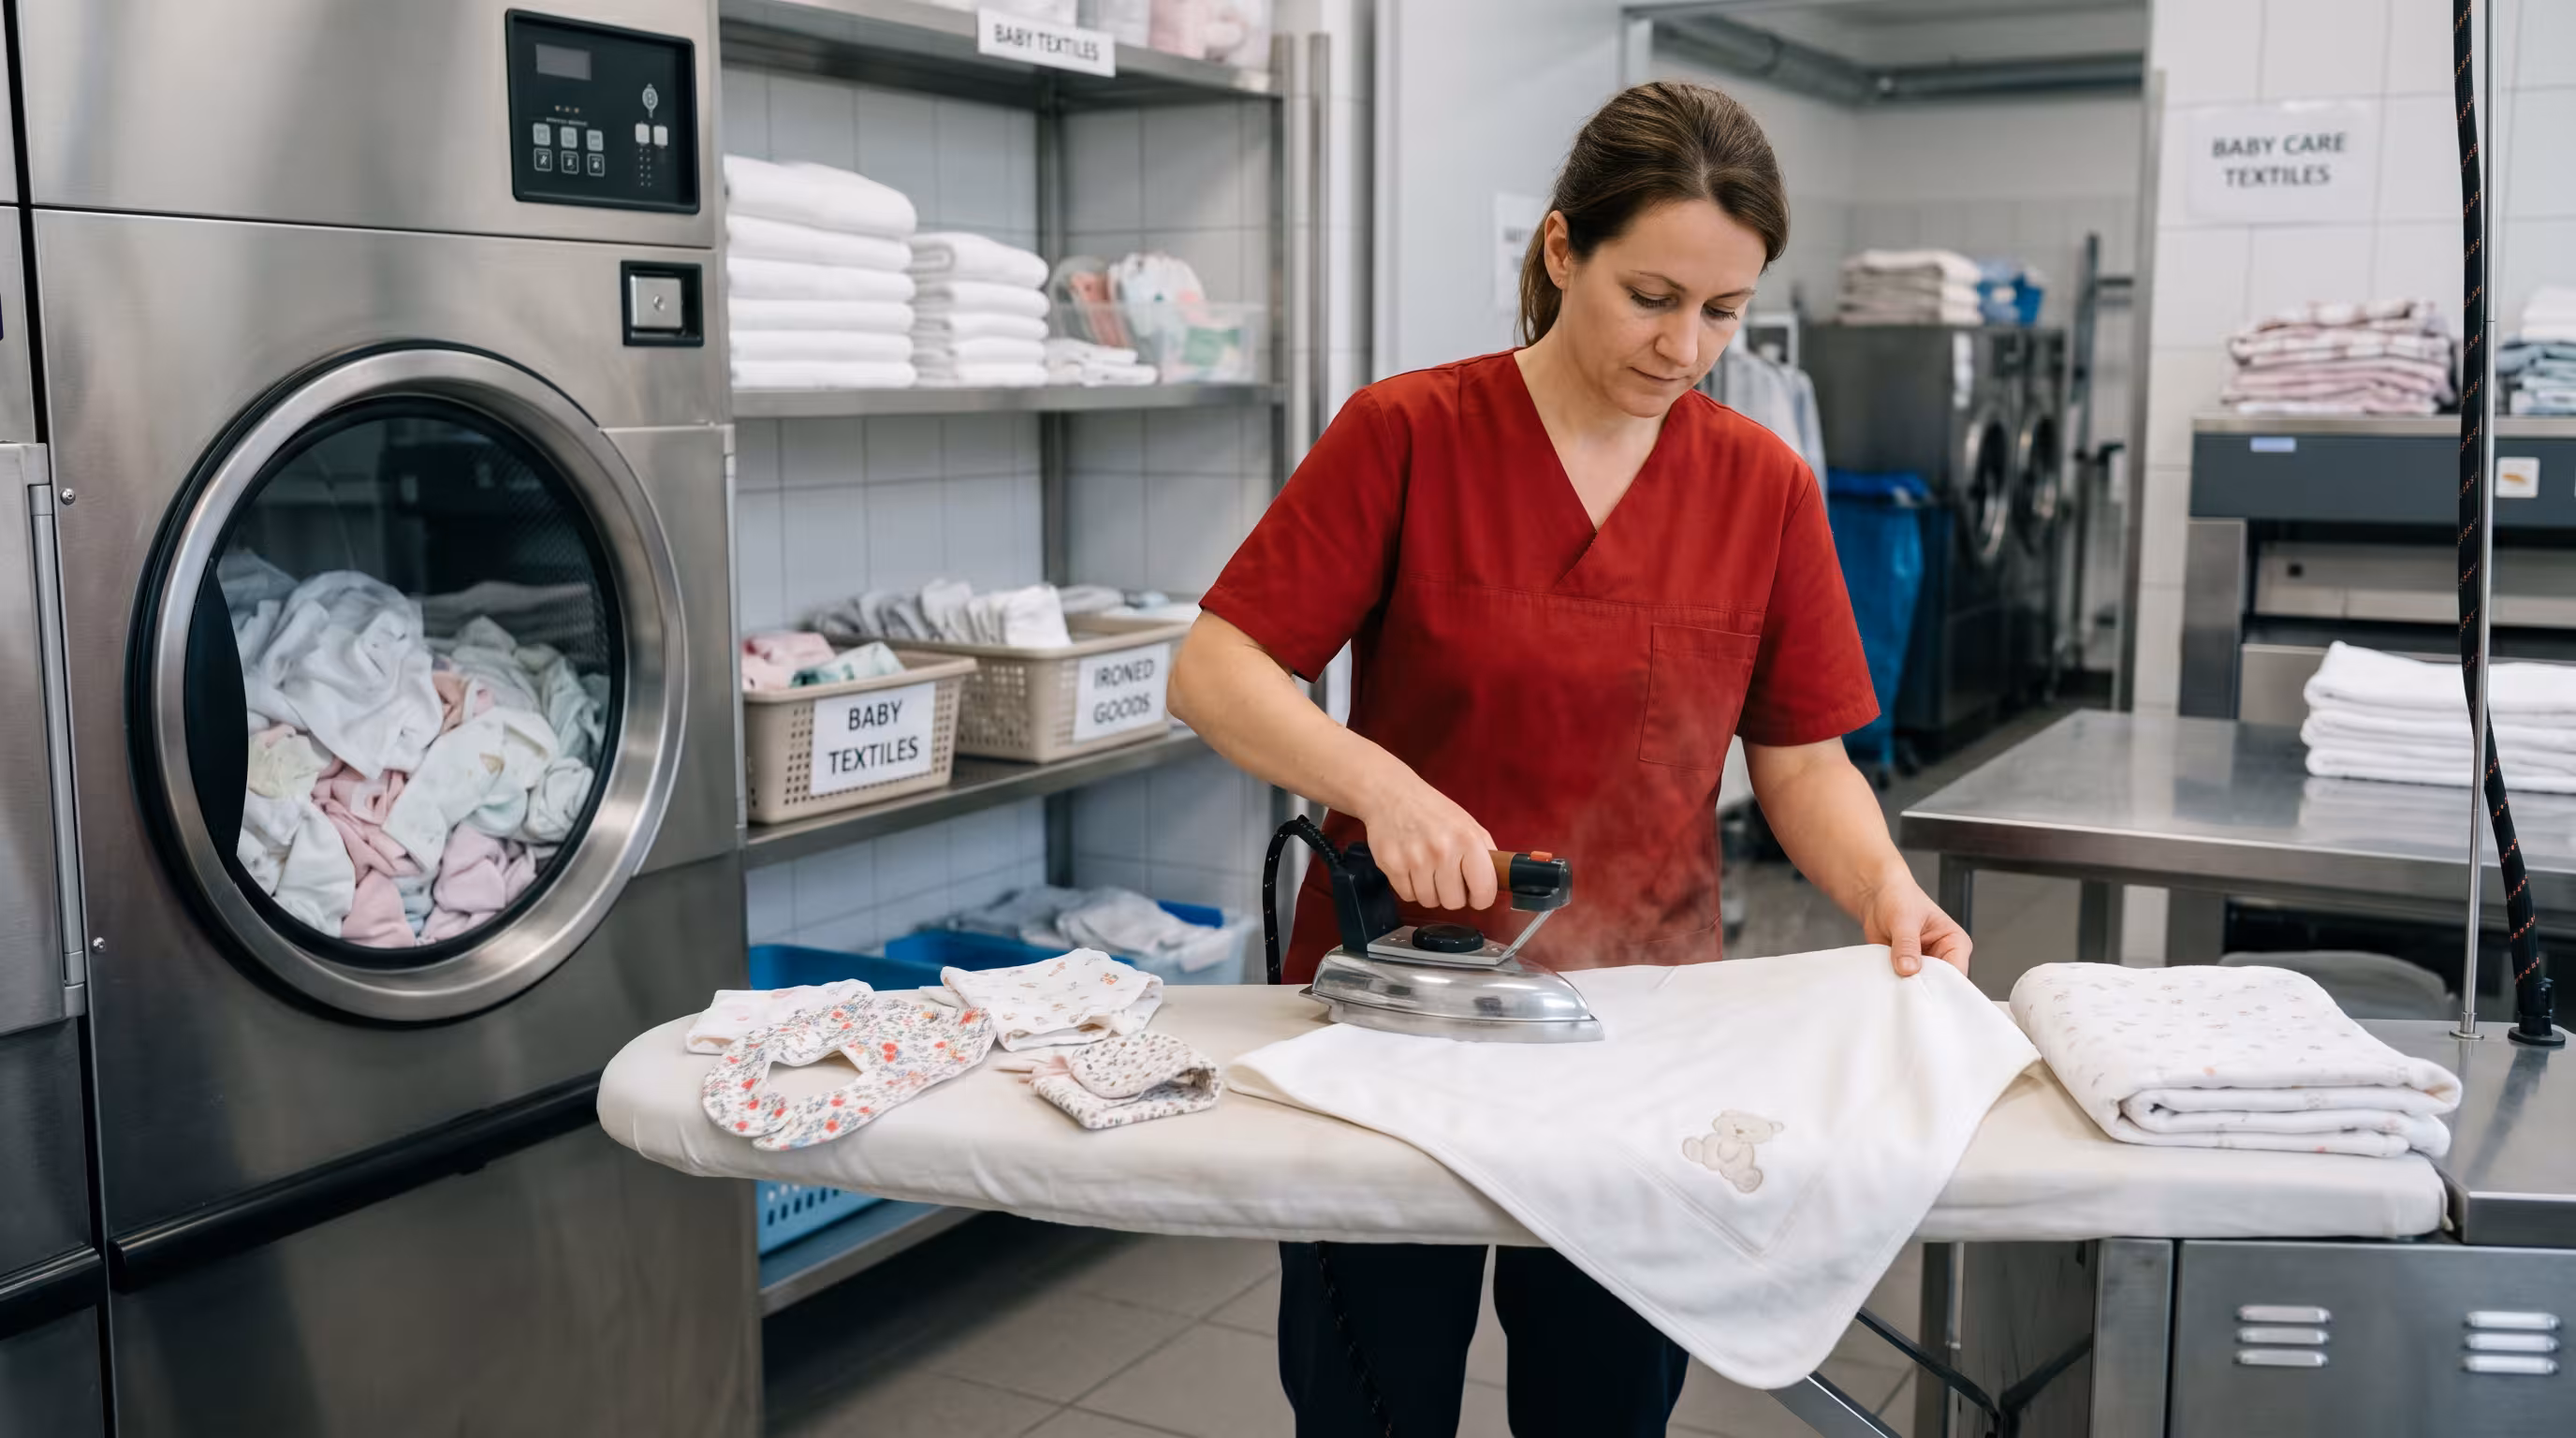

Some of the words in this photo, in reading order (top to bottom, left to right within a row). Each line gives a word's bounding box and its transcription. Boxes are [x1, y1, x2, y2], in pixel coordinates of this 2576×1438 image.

[994, 23, 1032, 48] BABY
[1037, 32, 1099, 62] TEXTILES
[2213, 137, 2276, 158] BABY
[2284, 133, 2346, 155] CARE
[2225, 164, 2331, 187] TEXTILES
[1093, 658, 1155, 689] IRONED
[848, 698, 902, 730] BABY
[1093, 693, 1150, 725] GOODS
[827, 736, 919, 775] TEXTILES
